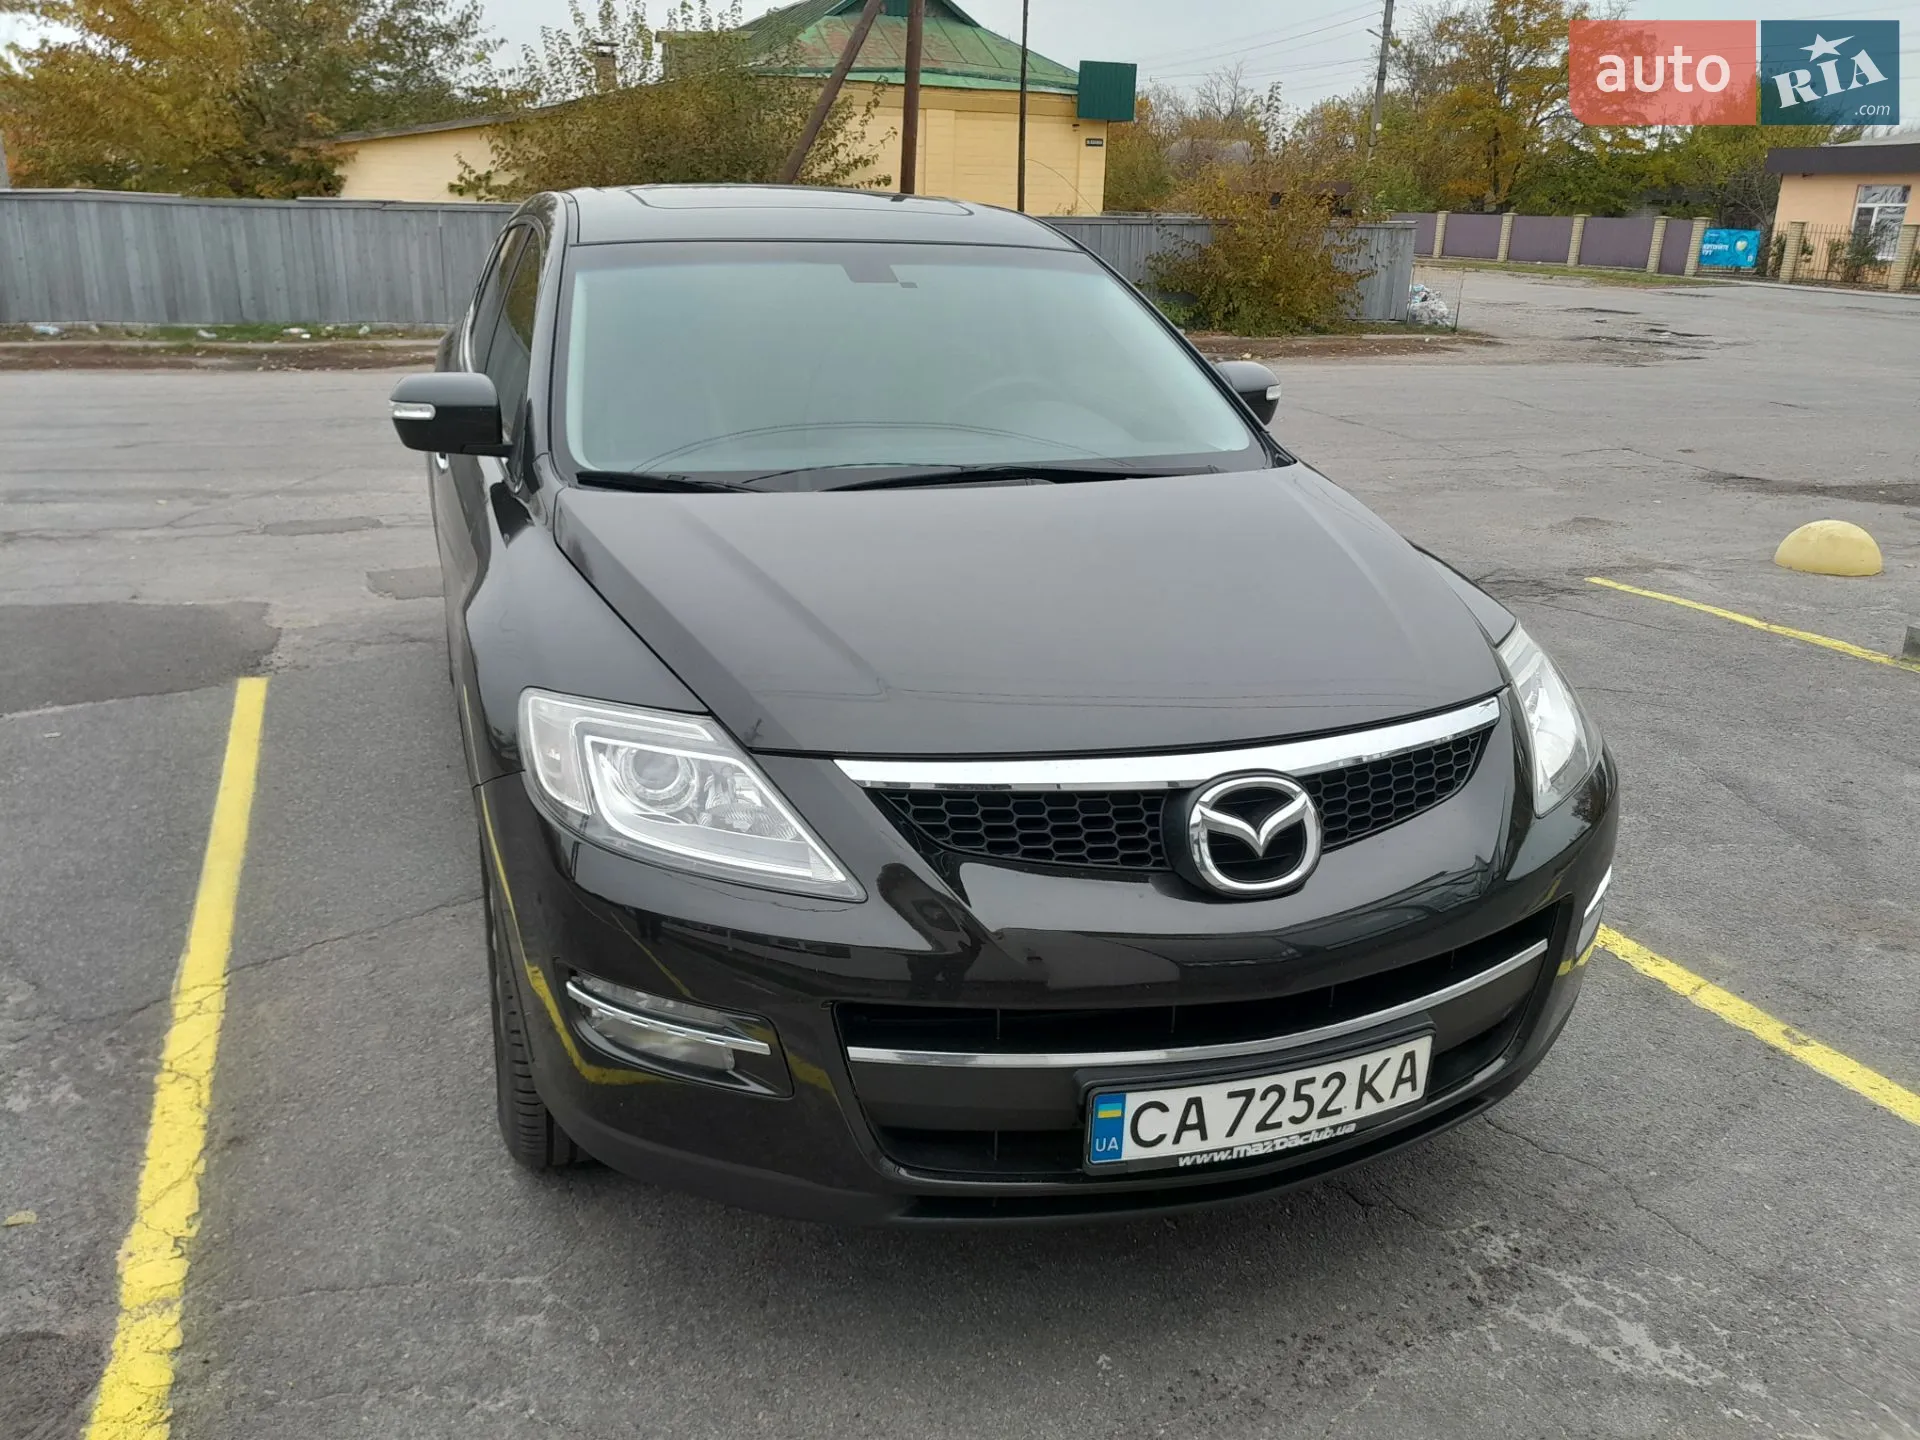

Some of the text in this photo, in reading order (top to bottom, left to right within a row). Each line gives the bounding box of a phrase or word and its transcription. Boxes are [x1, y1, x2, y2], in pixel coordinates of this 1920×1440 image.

[1130, 1049, 1418, 1148] CA 7252 KA
[1095, 1137, 1119, 1153] UA
